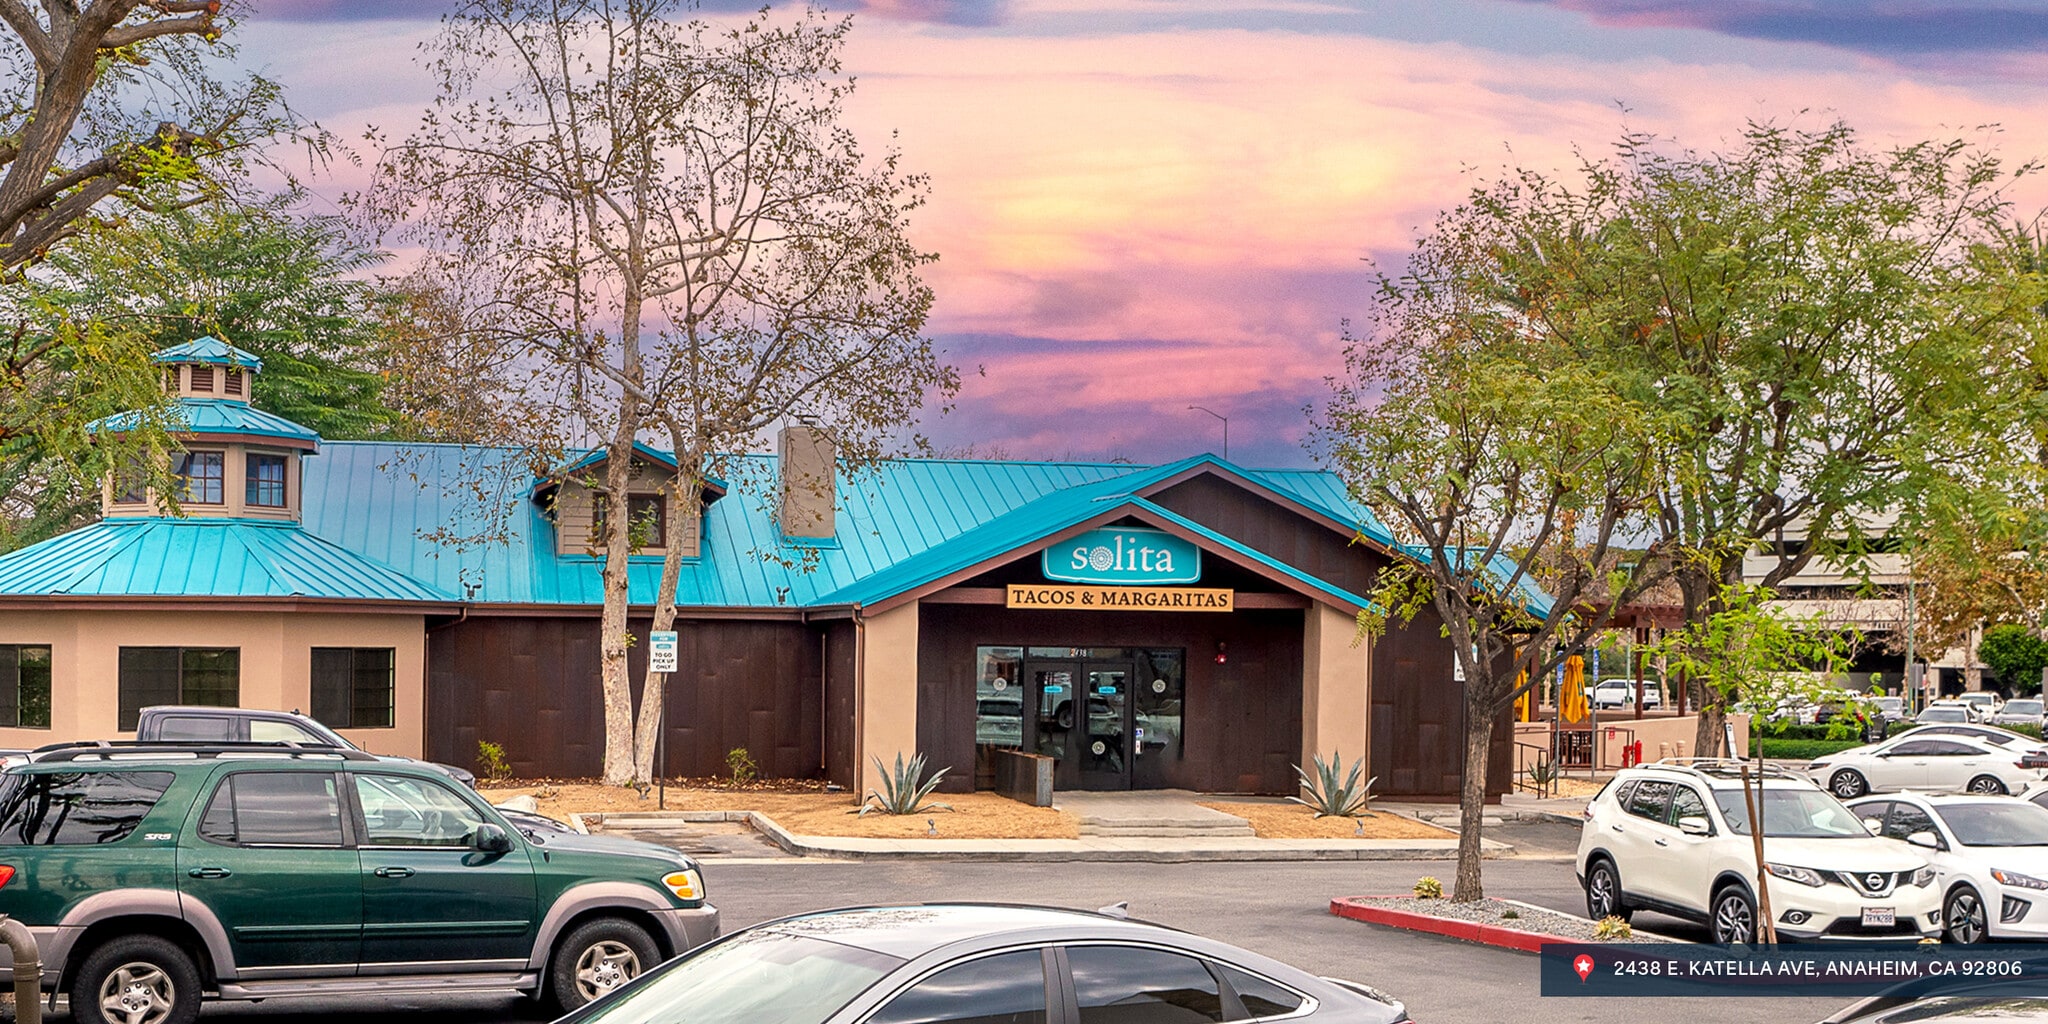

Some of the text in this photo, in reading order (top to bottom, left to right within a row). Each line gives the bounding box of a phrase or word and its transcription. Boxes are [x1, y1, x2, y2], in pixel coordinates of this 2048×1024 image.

[1070, 535, 1175, 573] solita
[1013, 590, 1228, 607] TACOS & MARGARITAS
